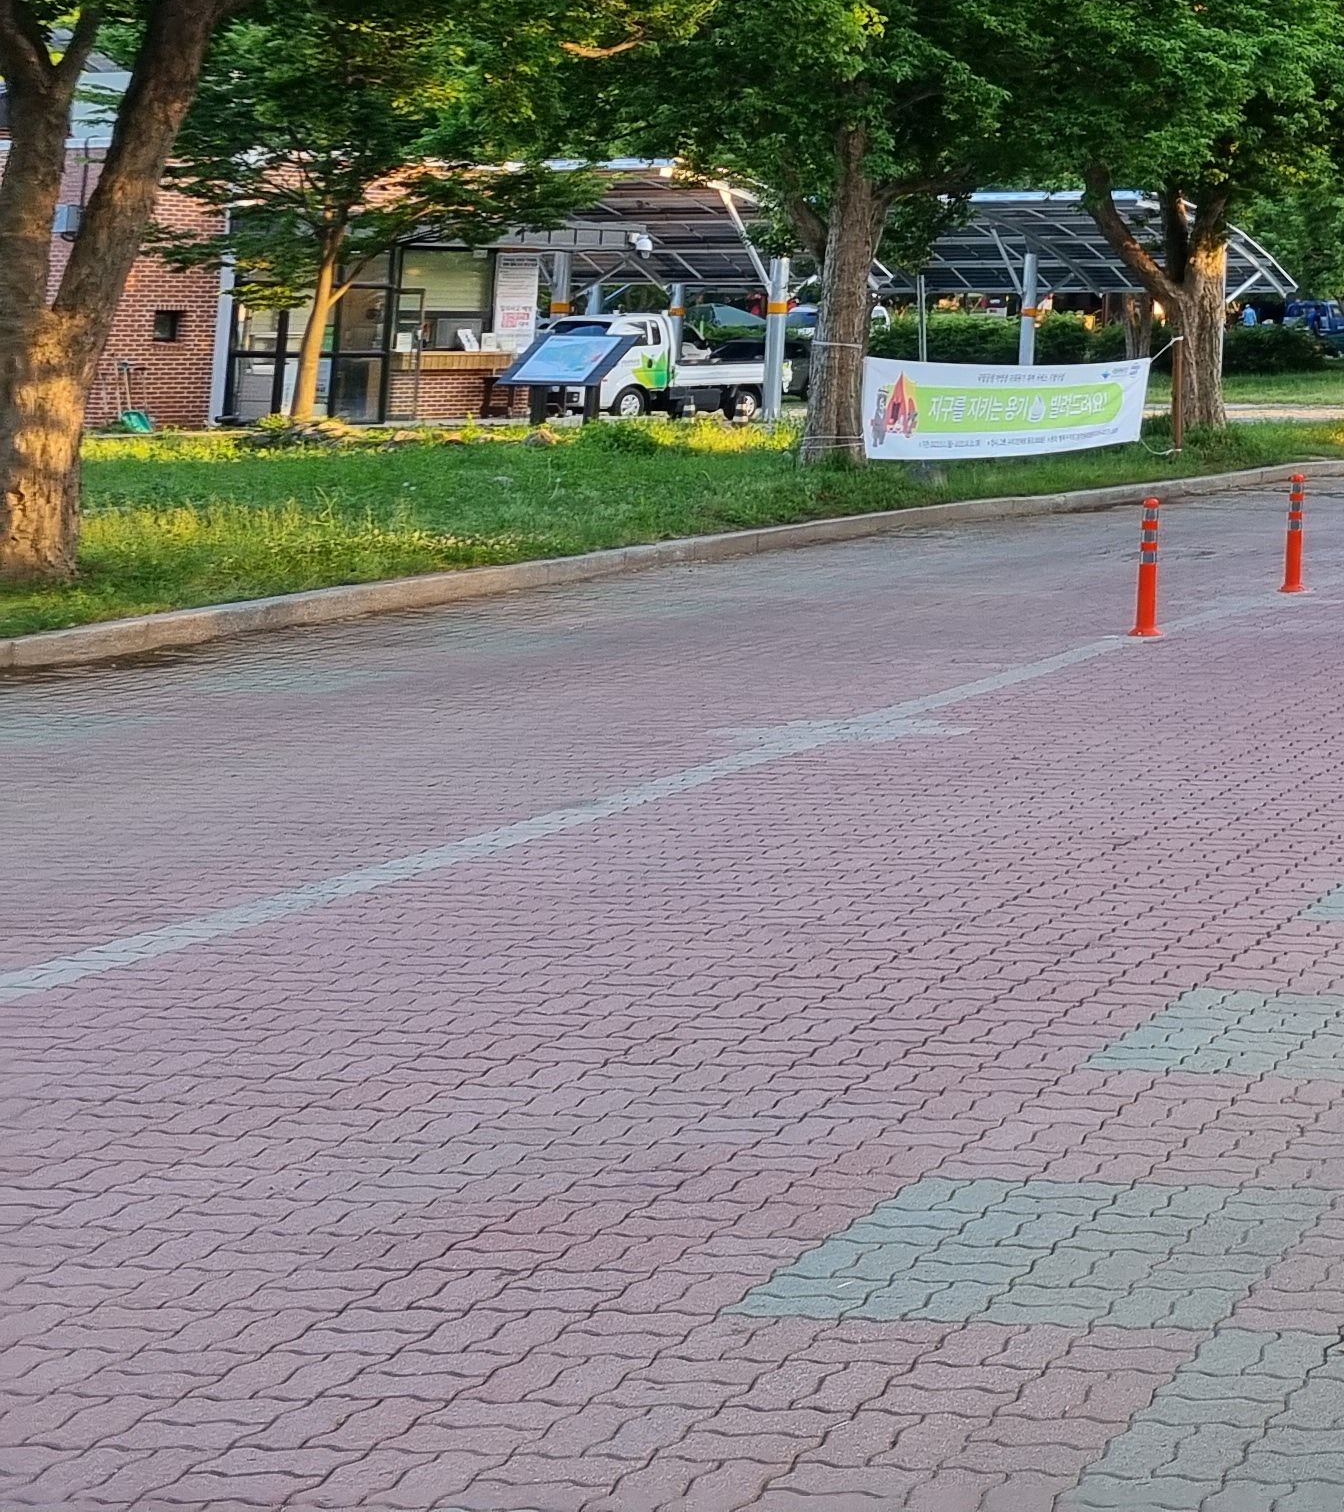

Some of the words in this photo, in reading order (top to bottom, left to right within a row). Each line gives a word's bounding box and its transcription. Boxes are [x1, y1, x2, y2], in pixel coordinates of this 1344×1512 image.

[928, 395, 966, 423] 지구를
[967, 395, 1003, 423] 지키는
[1004, 395, 1031, 422] 용기
